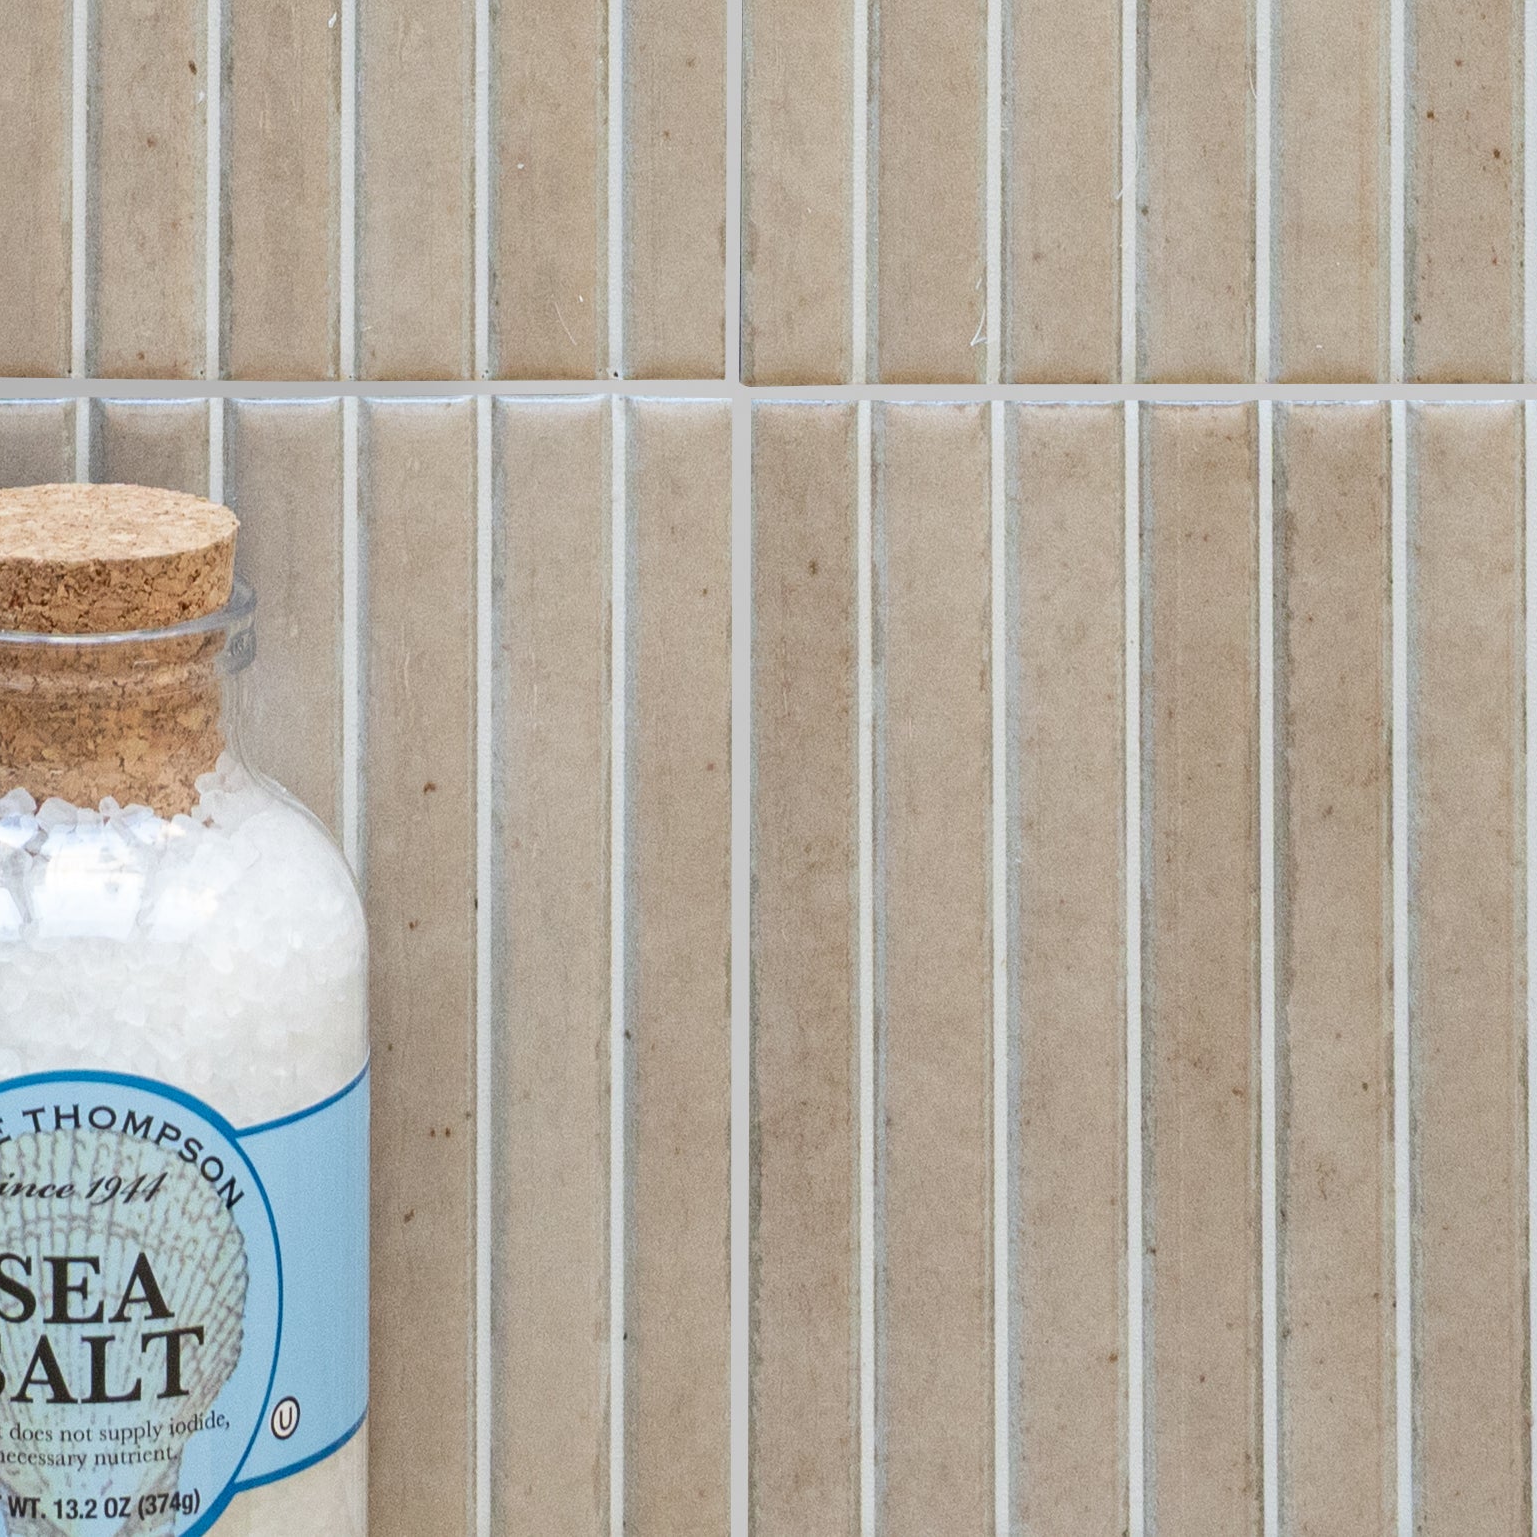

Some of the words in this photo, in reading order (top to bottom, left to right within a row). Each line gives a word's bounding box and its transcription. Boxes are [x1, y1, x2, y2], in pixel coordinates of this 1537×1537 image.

[21, 1104, 246, 1211] THOMPSON
[84, 1172, 170, 1206] 1944
[9, 1419, 55, 1442] does
[59, 1422, 93, 1444] not
[98, 1417, 163, 1449] supply
[169, 1410, 231, 1439] iodide,
[94, 1443, 178, 1469] nutrient.
[8, 1496, 47, 1519] WT.
[53, 1497, 98, 1520] 13.2
[104, 1496, 132, 1517] OZ
[137, 1488, 200, 1522] (374g)
